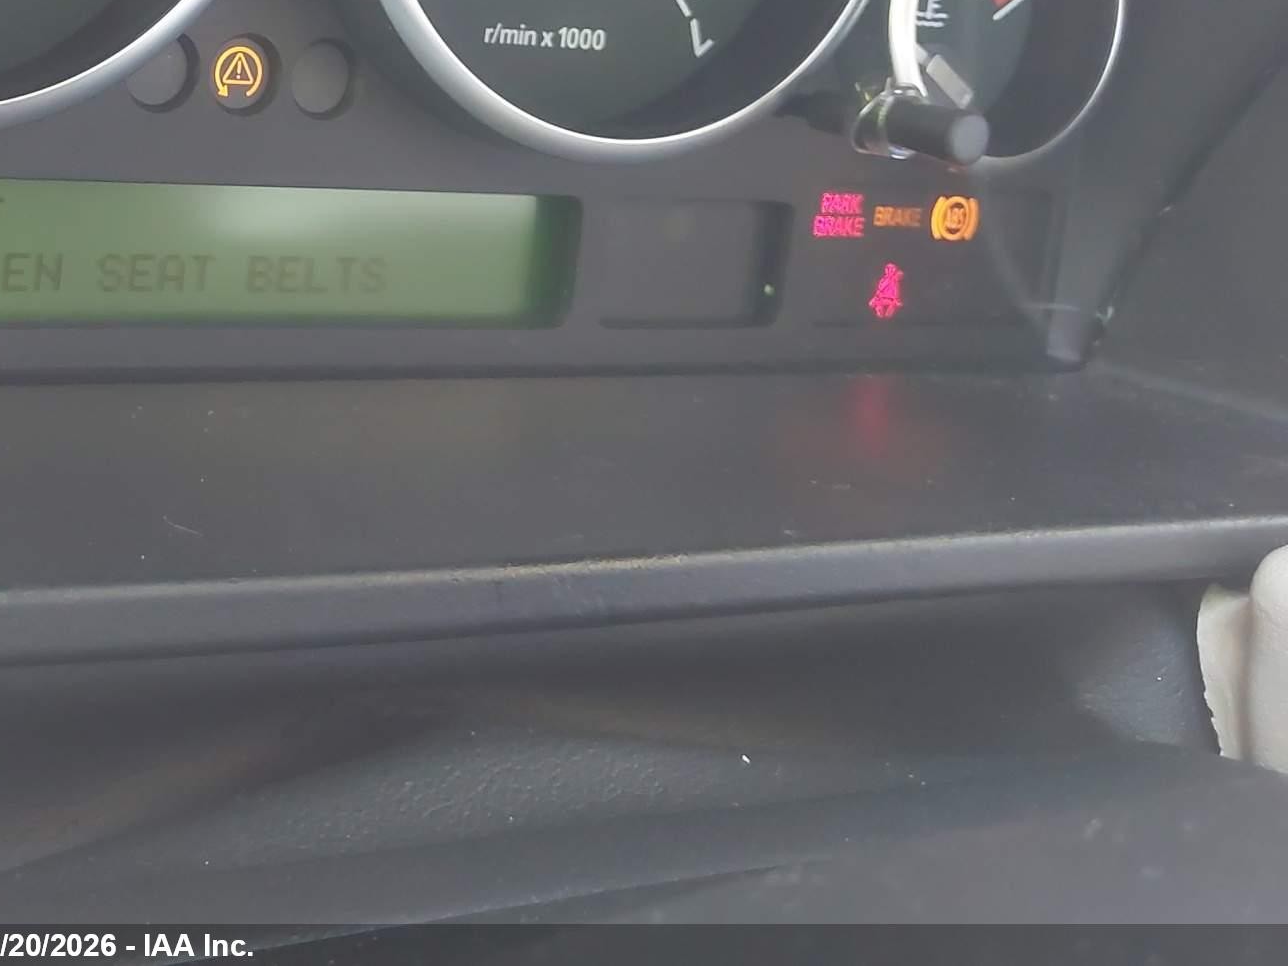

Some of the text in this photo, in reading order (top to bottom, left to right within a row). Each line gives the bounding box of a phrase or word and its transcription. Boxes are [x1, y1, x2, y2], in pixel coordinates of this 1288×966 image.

[483, 23, 607, 51] r/min x 1000
[691, 19, 714, 57] 7
[821, 192, 864, 214] PARK
[813, 215, 864, 237] BRAKE
[873, 206, 922, 226] BRAKE
[97, 252, 215, 293] SEAT
[248, 256, 388, 294] BELTS
